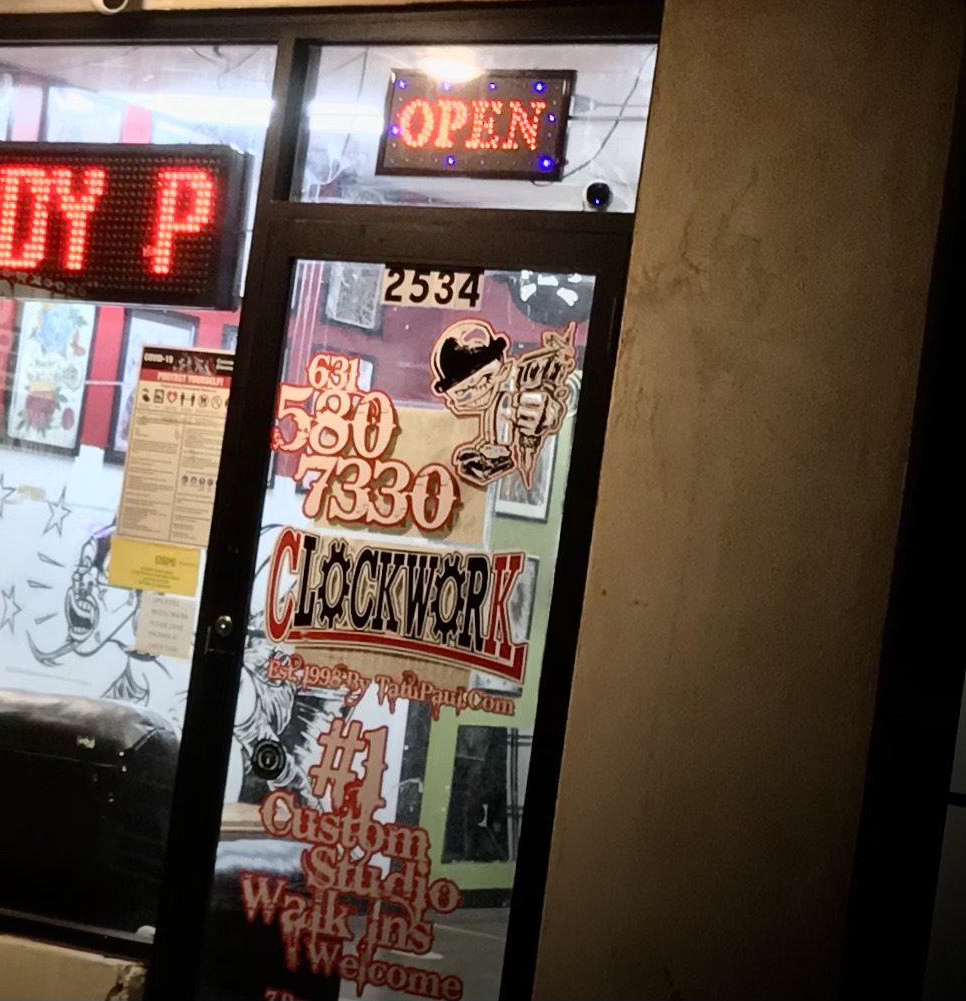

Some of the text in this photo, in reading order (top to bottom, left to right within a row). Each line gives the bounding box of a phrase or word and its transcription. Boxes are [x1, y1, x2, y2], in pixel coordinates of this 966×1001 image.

[397, 97, 546, 152] OPEN
[150, 168, 215, 276] P
[384, 268, 480, 308] 2534
[307, 352, 360, 391] 631
[270, 384, 399, 458] 580
[295, 456, 461, 531] 7330
[266, 528, 526, 662] CLOCKWORK
[302, 664, 343, 691] 1998
[345, 670, 371, 707] By
[308, 716, 388, 810] #1
[259, 788, 431, 860] Custom
[239, 872, 357, 942] Walk
[301, 843, 463, 915] Studio
[284, 938, 463, 1000] Welcome
